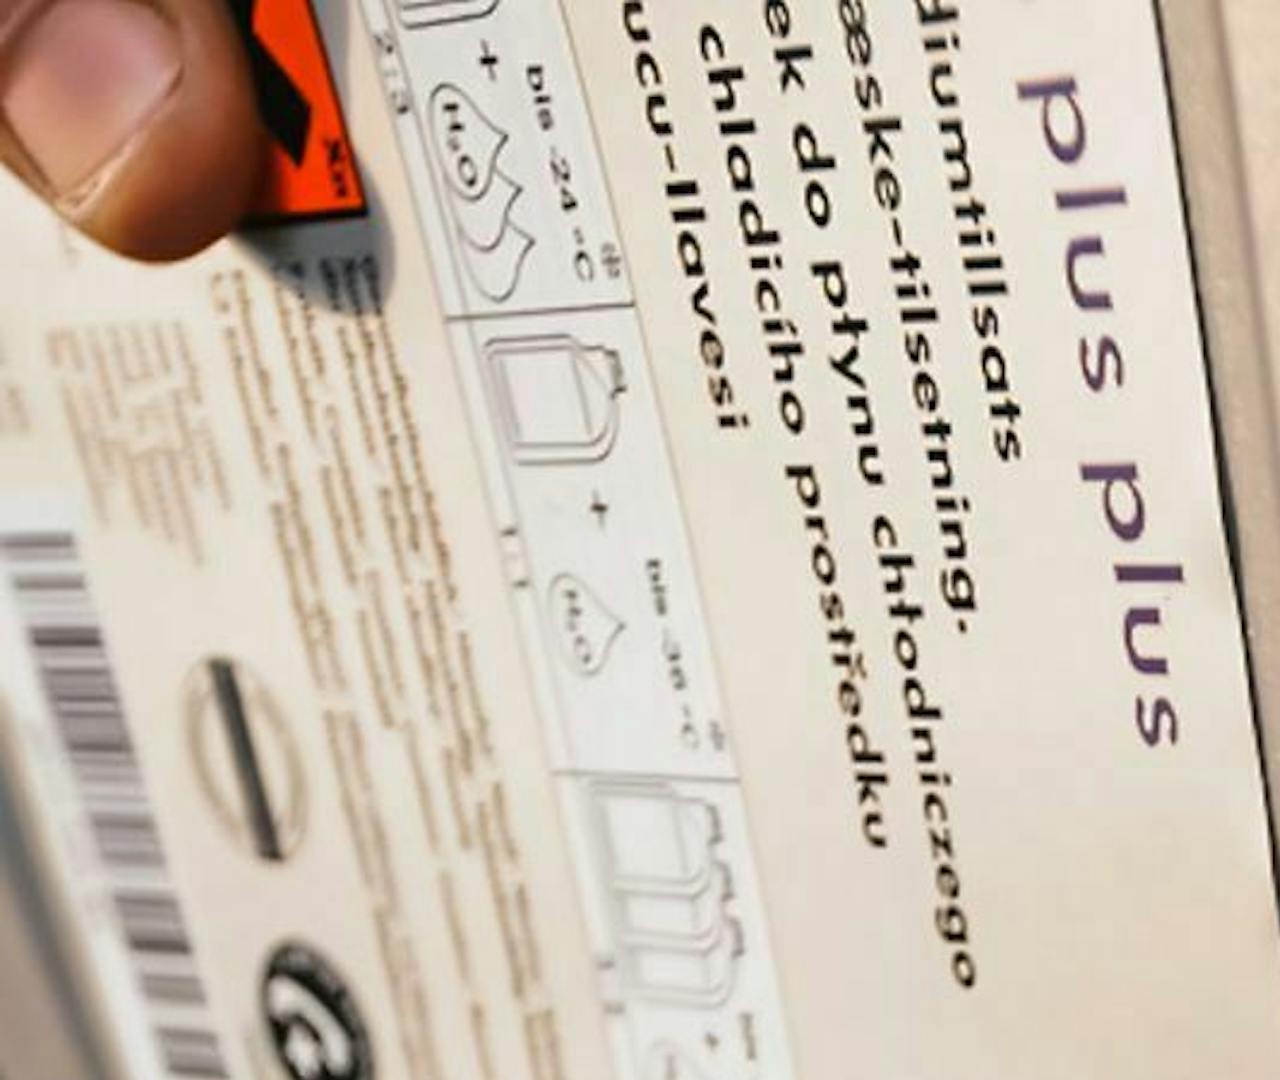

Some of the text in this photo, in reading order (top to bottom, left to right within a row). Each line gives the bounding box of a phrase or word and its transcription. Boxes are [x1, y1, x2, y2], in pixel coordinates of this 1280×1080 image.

[526, 64, 555, 132] bis
[793, 122, 837, 229] do
[699, 24, 890, 849] chladicího prostředku
[811, 261, 885, 487] płynu
[1016, 75, 1184, 748] plus plus
[873, 515, 979, 990] chłodniczego
